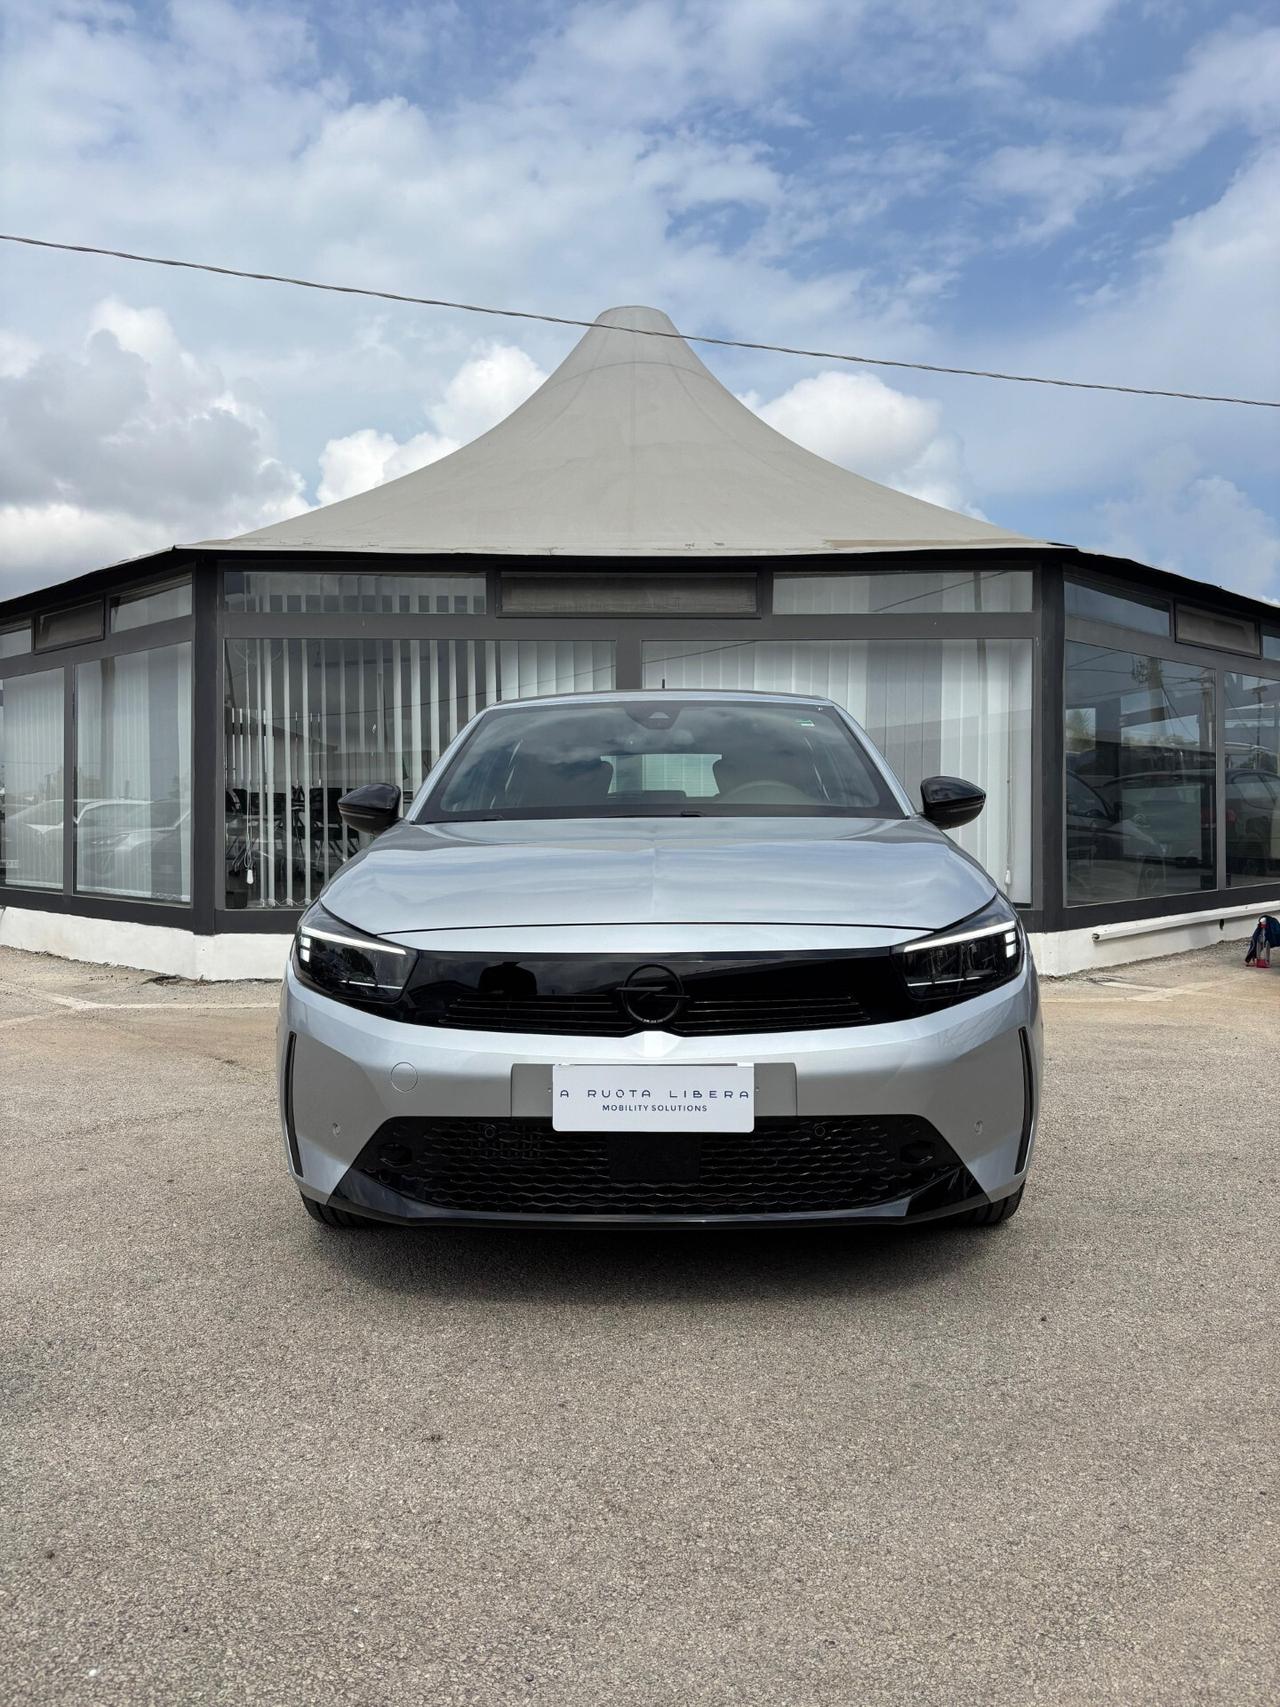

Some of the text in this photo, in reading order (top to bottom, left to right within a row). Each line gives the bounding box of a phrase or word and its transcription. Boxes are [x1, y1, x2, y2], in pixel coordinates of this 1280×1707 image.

[559, 1089, 749, 1099] A RUOTA LIBERA
[602, 1104, 708, 1112] MOBILITY SOLUTIONS
